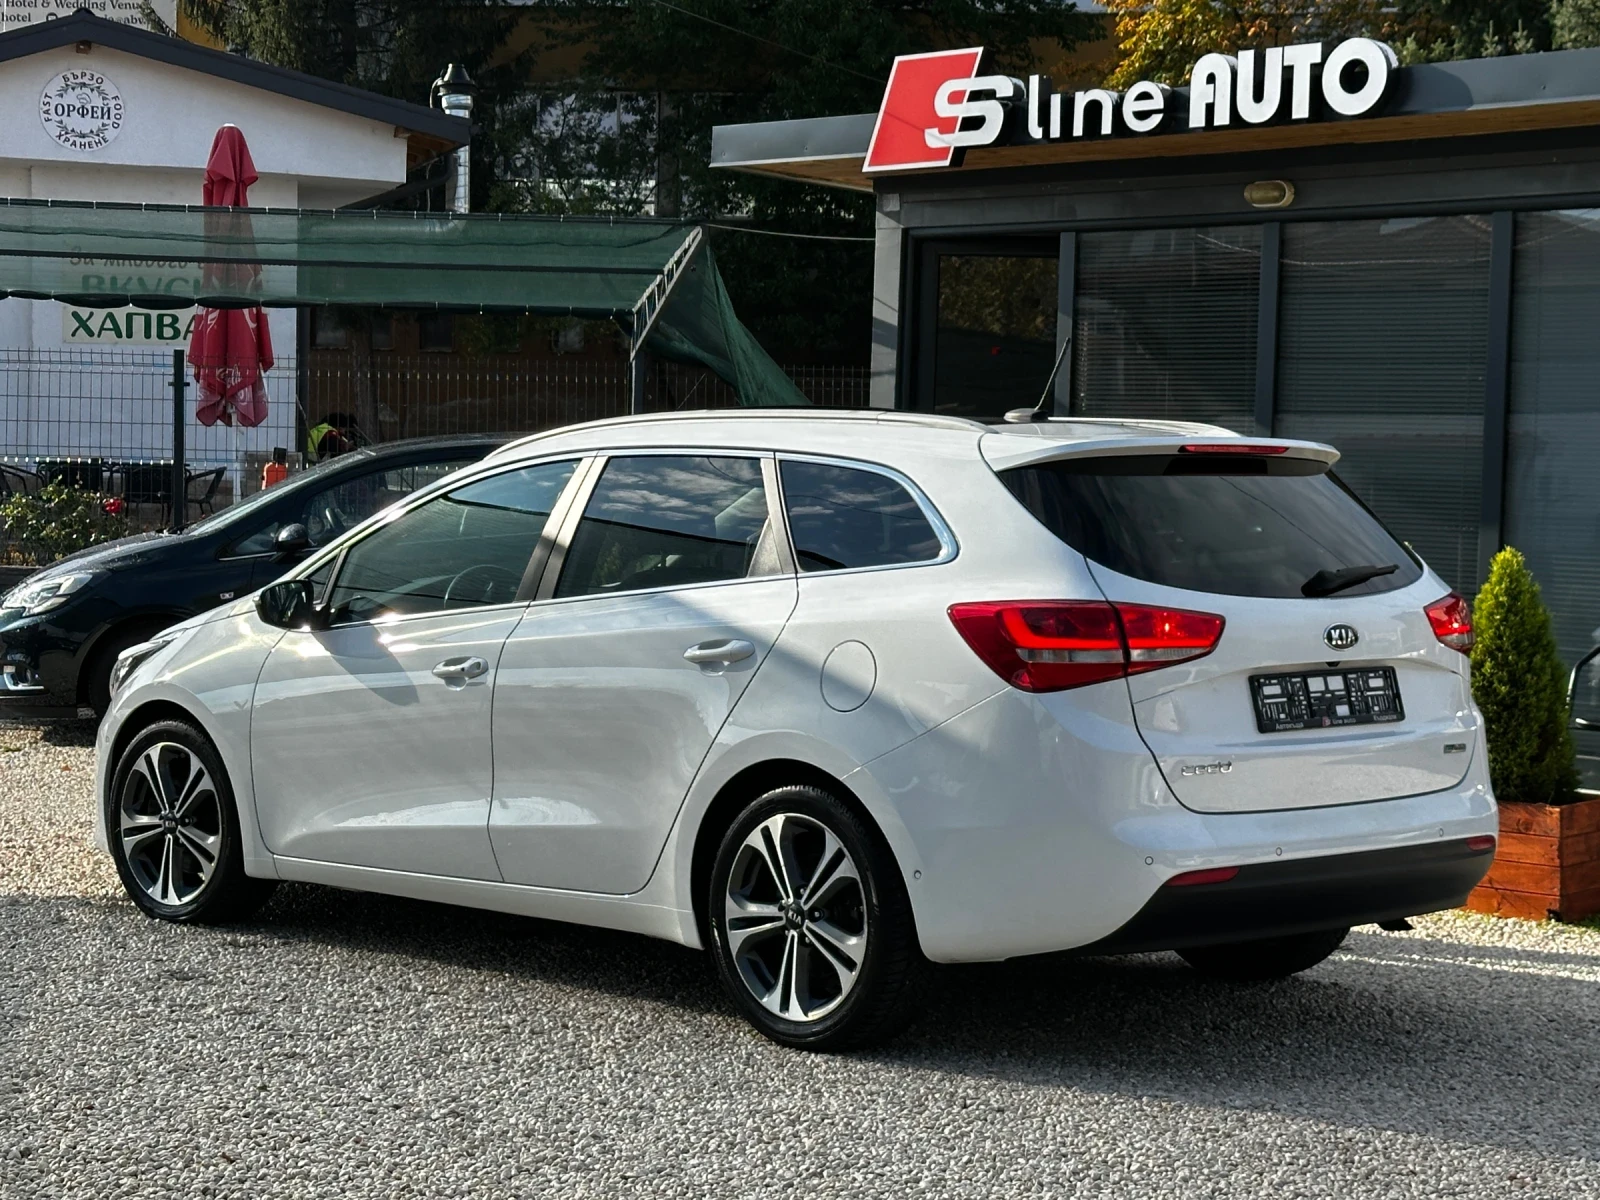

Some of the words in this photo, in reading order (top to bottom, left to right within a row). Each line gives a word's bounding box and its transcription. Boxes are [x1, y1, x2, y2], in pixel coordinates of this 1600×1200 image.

[6, 0, 37, 8] Hotel
[54, 0, 106, 11] Wedding
[109, 0, 142, 10] Venu
[62, 71, 104, 85] БЪРЗО
[1027, 74, 1165, 139] line
[1189, 37, 1388, 129] AUTO
[42, 92, 53, 123] FAST
[54, 102, 111, 120] ОРФЕЙ
[111, 95, 122, 129] FOOD
[56, 131, 109, 149] ХРАНЕНЕ
[787, 909, 802, 925] KIA
